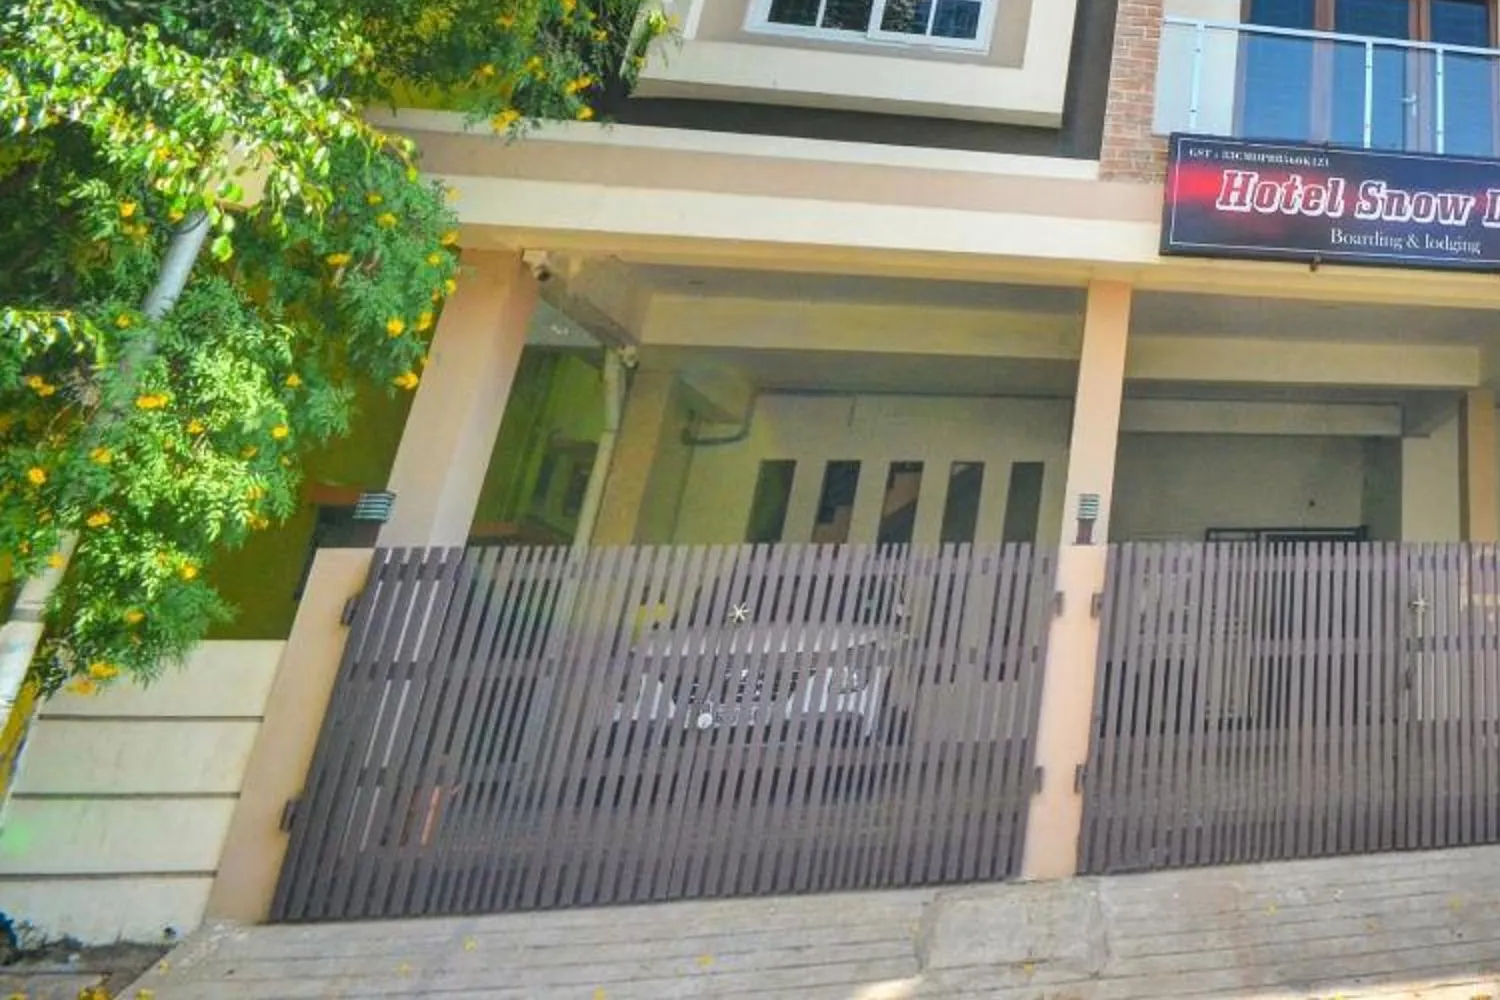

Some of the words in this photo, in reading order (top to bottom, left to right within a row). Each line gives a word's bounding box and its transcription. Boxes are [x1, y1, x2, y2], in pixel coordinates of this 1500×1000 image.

[1216, 169, 1345, 218] Hotel
[1354, 179, 1476, 226] Snow
[1331, 227, 1402, 250] Boarding
[1406, 233, 1420, 249] &
[1425, 232, 1482, 254] lodging
